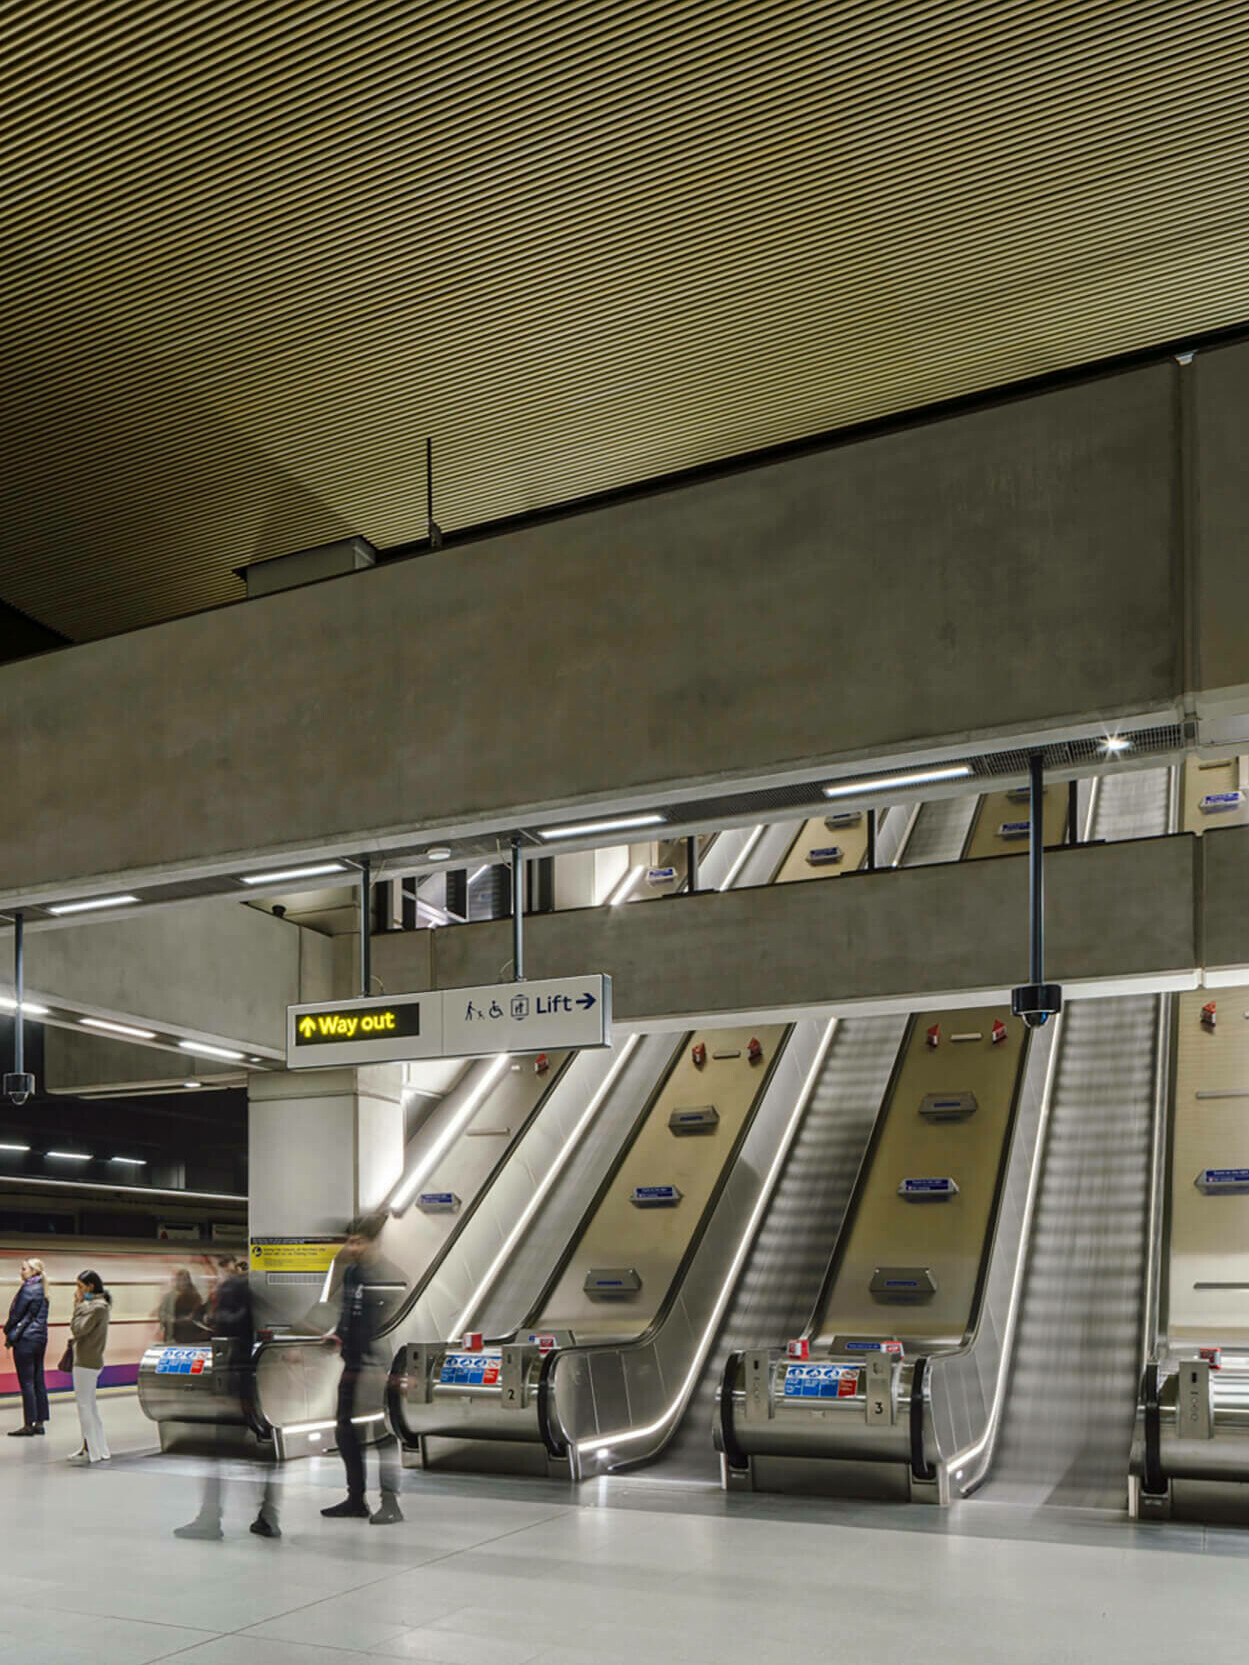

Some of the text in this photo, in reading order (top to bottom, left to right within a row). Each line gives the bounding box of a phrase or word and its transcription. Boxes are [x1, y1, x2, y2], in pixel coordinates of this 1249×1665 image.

[536, 995, 572, 1014] Lift
[318, 1012, 395, 1037] Way out
[508, 1389, 515, 1400] 2
[874, 1401, 883, 1415] 3
